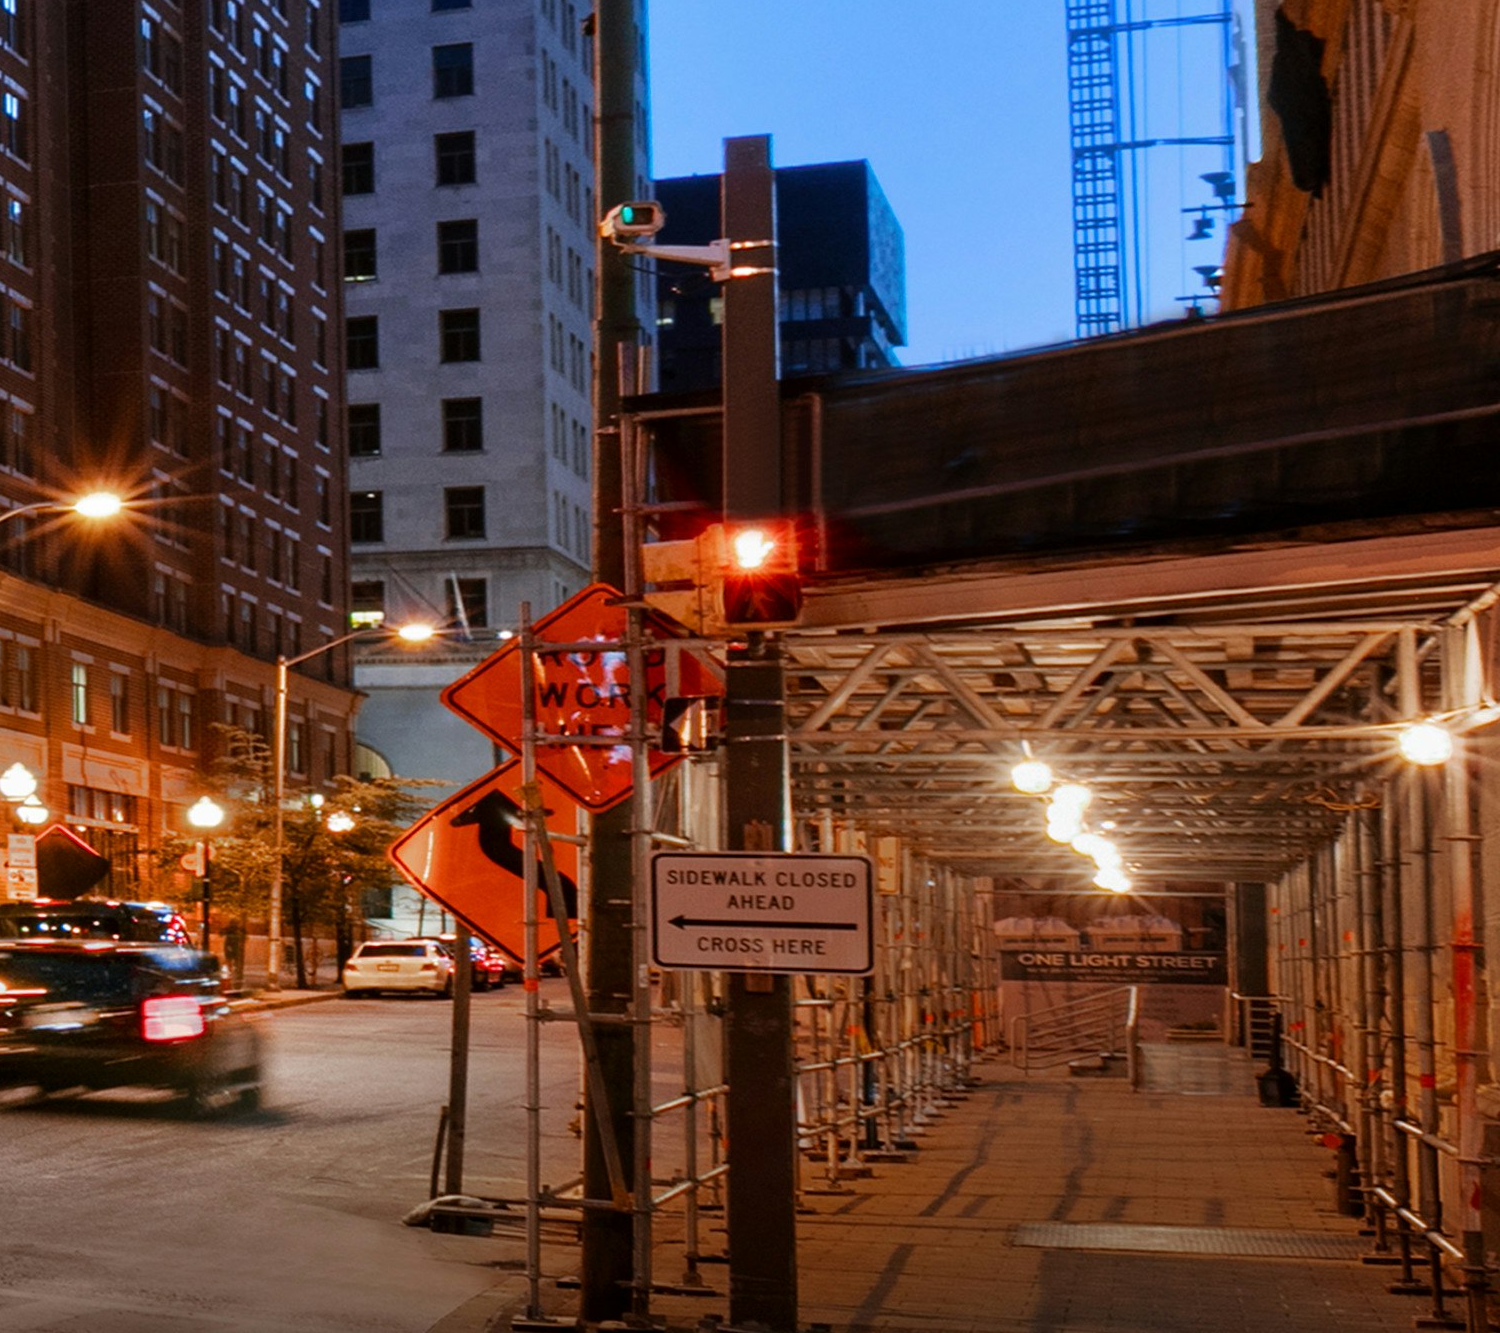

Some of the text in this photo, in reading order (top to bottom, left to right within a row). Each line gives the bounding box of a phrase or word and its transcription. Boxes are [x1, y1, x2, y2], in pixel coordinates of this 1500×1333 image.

[666, 869, 857, 889] SIDEWALK CLOSED
[726, 895, 796, 911] AHEAD
[697, 936, 827, 955] CROSS HERE
[1017, 953, 1218, 969] ONE LIGHT STREET
